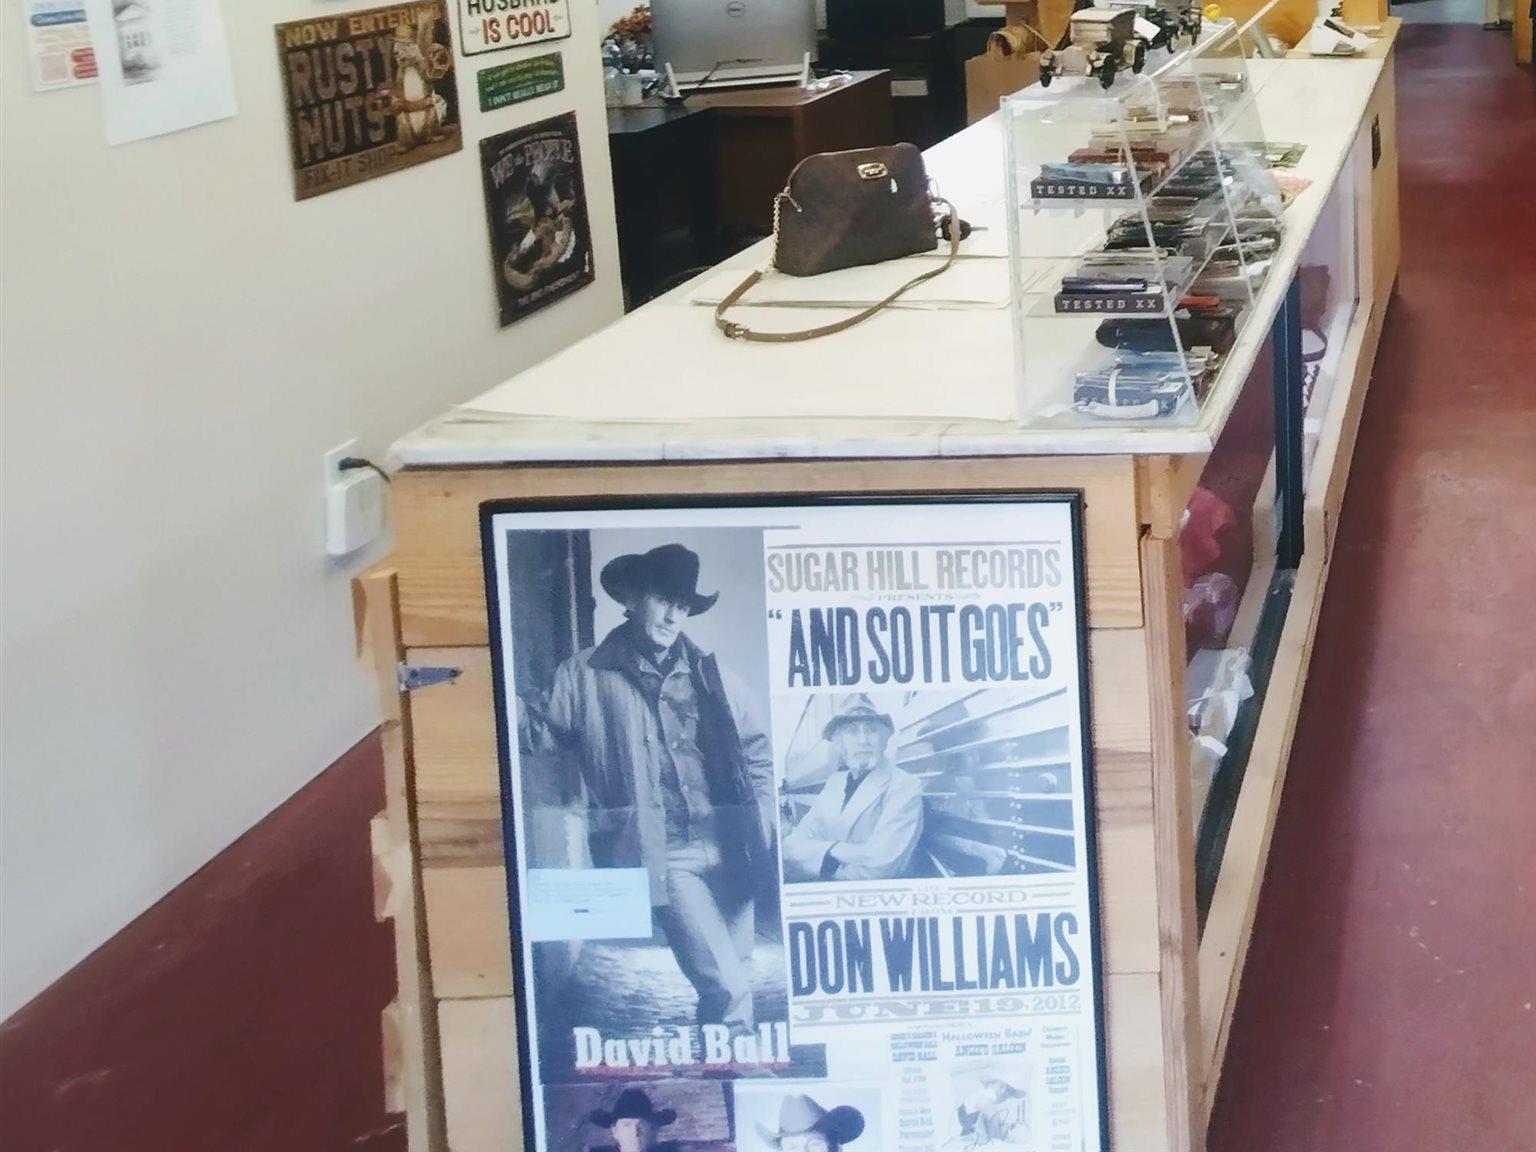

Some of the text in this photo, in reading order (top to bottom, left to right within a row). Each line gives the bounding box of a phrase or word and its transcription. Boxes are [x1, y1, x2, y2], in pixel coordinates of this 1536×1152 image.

[284, 20, 339, 48] NOW
[482, 8, 556, 45] IS COOL
[287, 33, 397, 109] RUSTY
[296, 94, 387, 165] NUTS
[1035, 185, 1127, 196] TESTED XX
[1061, 298, 1157, 310] TESTED XX
[767, 549, 1063, 593] SUGAR HILL RECORDS
[878, 593, 955, 601] PRESENTS
[865, 606, 915, 685] SO
[919, 605, 956, 684] IT
[834, 889, 1029, 910] NEW RECORD
[788, 912, 1081, 997] DON WILLIAMS
[793, 999, 970, 1022] JUNE
[1030, 995, 1082, 1012] 2012
[573, 1021, 791, 1069] David Ball
[942, 1031, 1001, 1042] HALLOWEEN
[1004, 1028, 1032, 1039] BASH!
